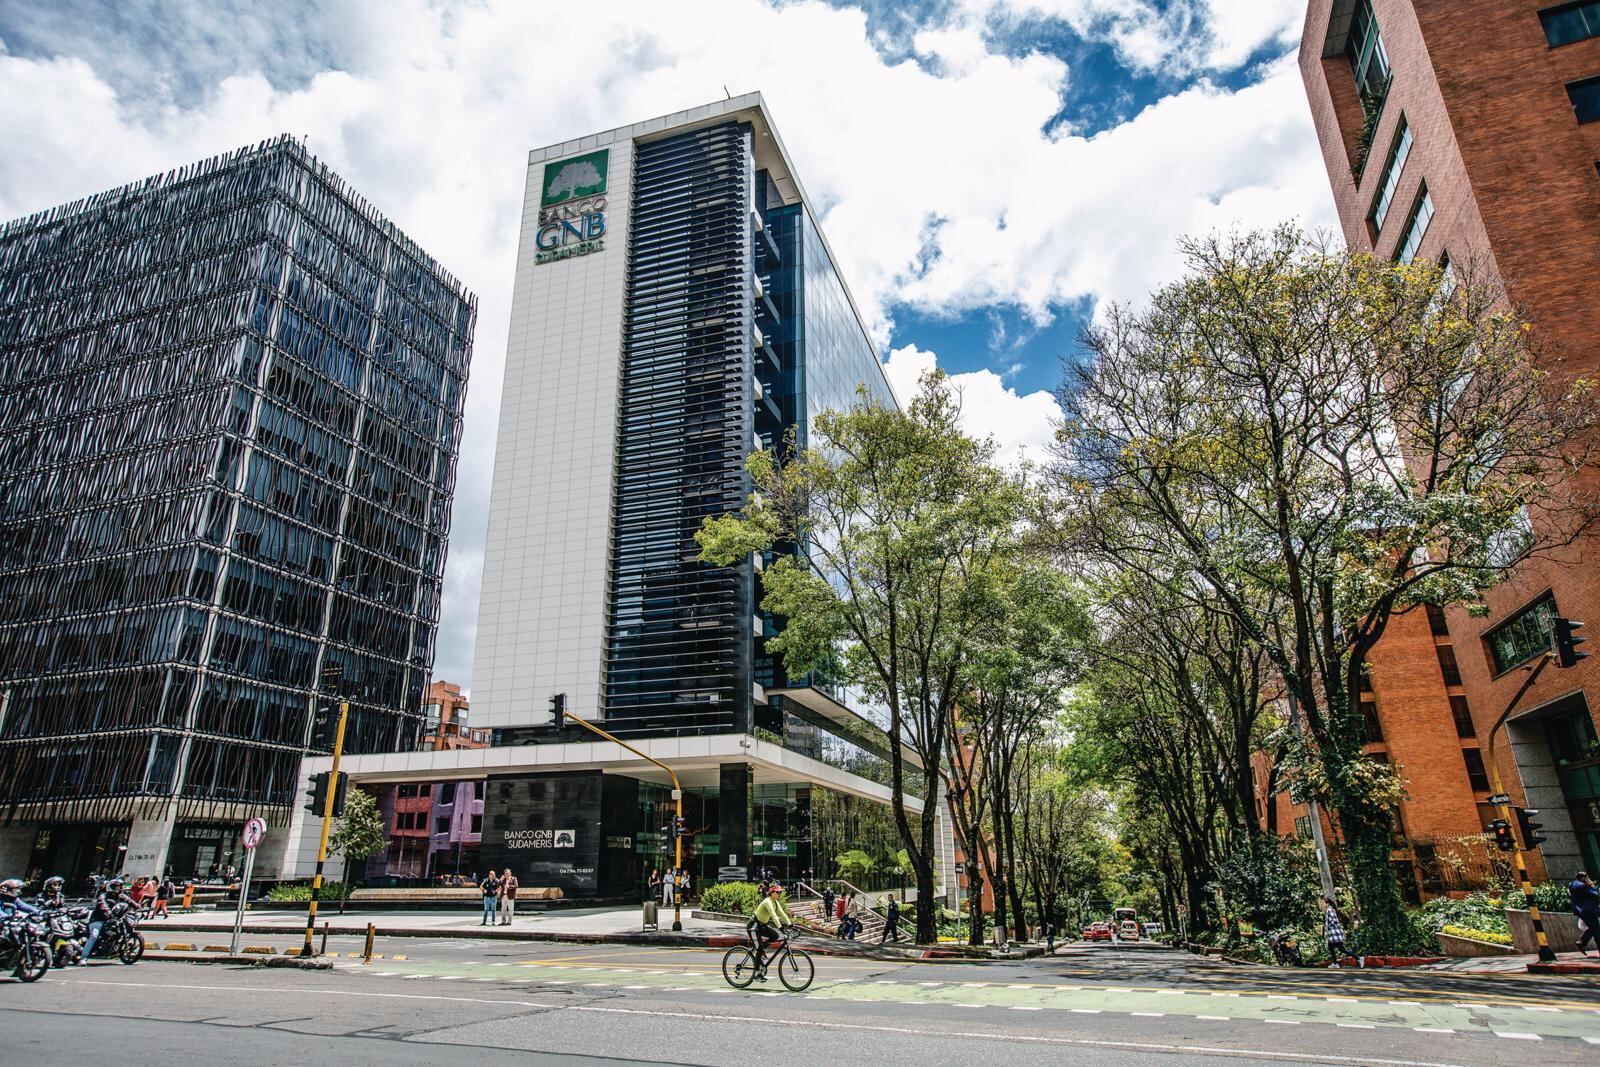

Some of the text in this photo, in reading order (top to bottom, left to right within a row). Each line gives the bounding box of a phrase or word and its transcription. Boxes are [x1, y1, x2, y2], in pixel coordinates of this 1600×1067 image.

[536, 212, 606, 251] GNB
[504, 830, 553, 840] BANCO GNB
[508, 839, 552, 848] SUDAMERIS
